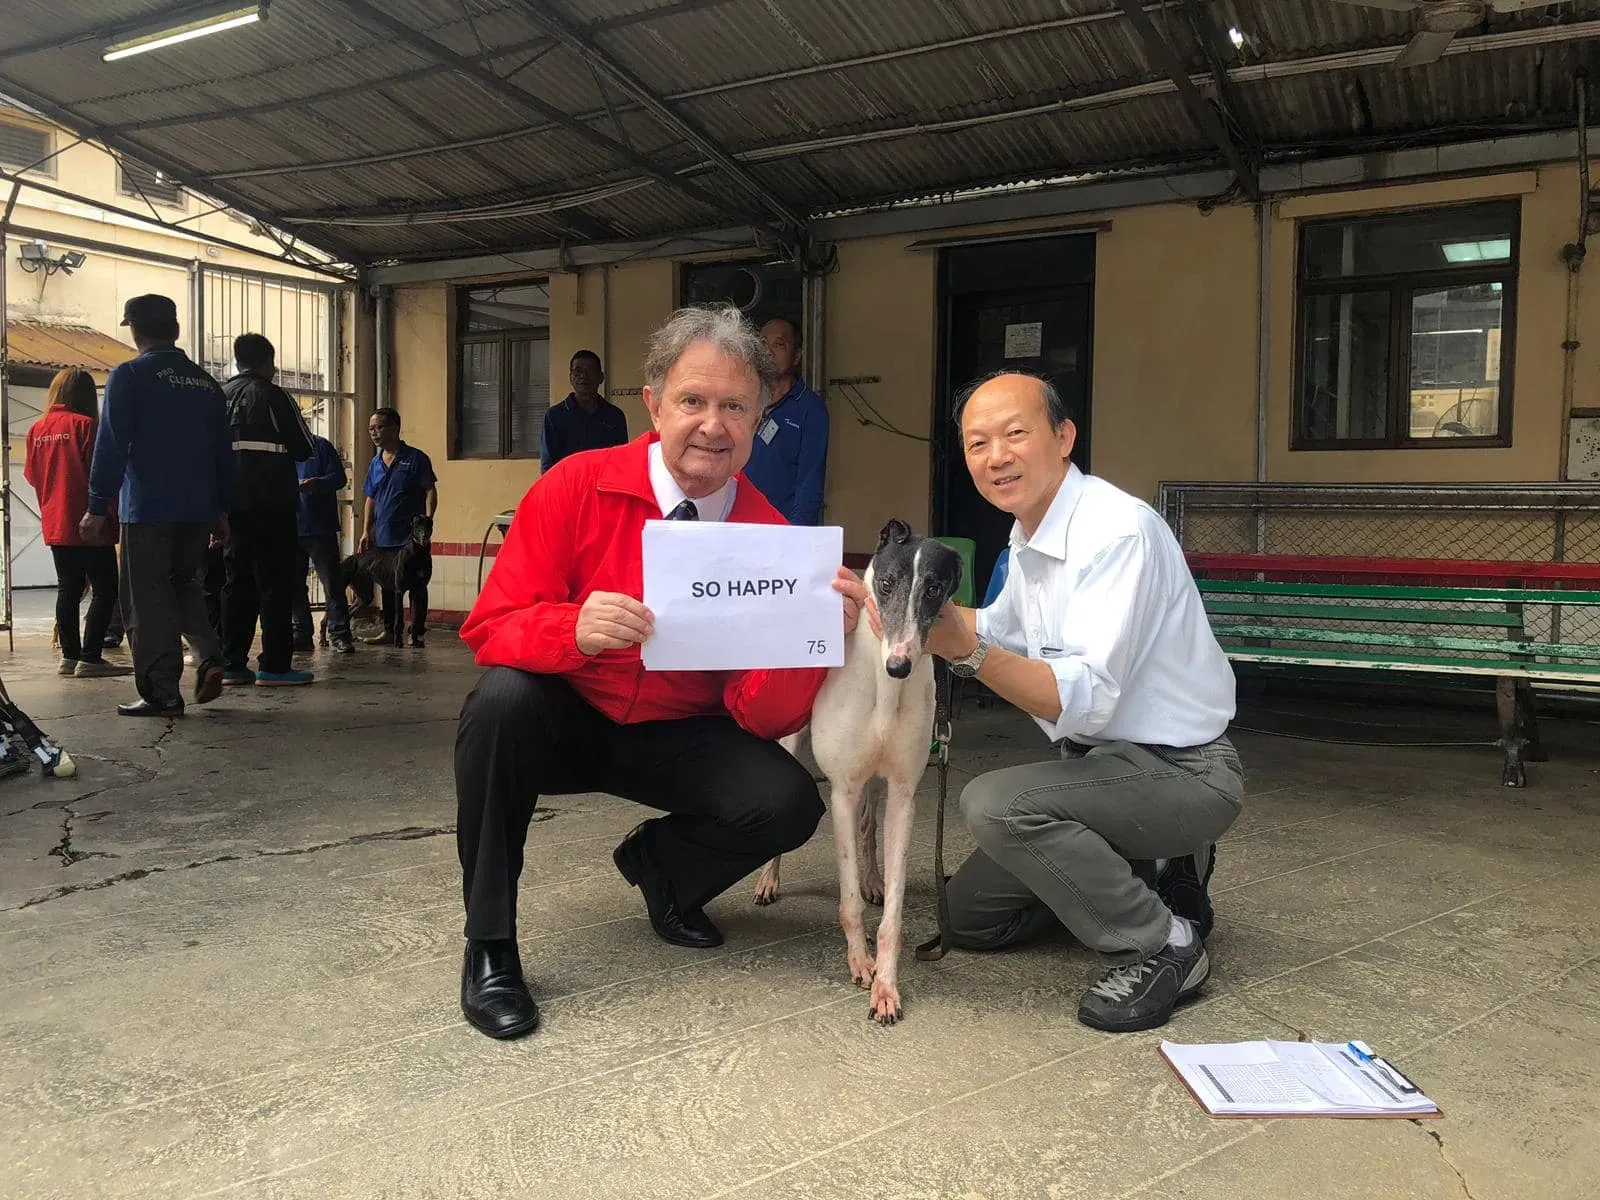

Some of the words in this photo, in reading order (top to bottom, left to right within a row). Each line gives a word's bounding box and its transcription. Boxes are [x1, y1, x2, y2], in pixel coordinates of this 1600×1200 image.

[691, 581, 721, 598] SO
[728, 579, 797, 597] HAPPY
[807, 640, 826, 654] 75
